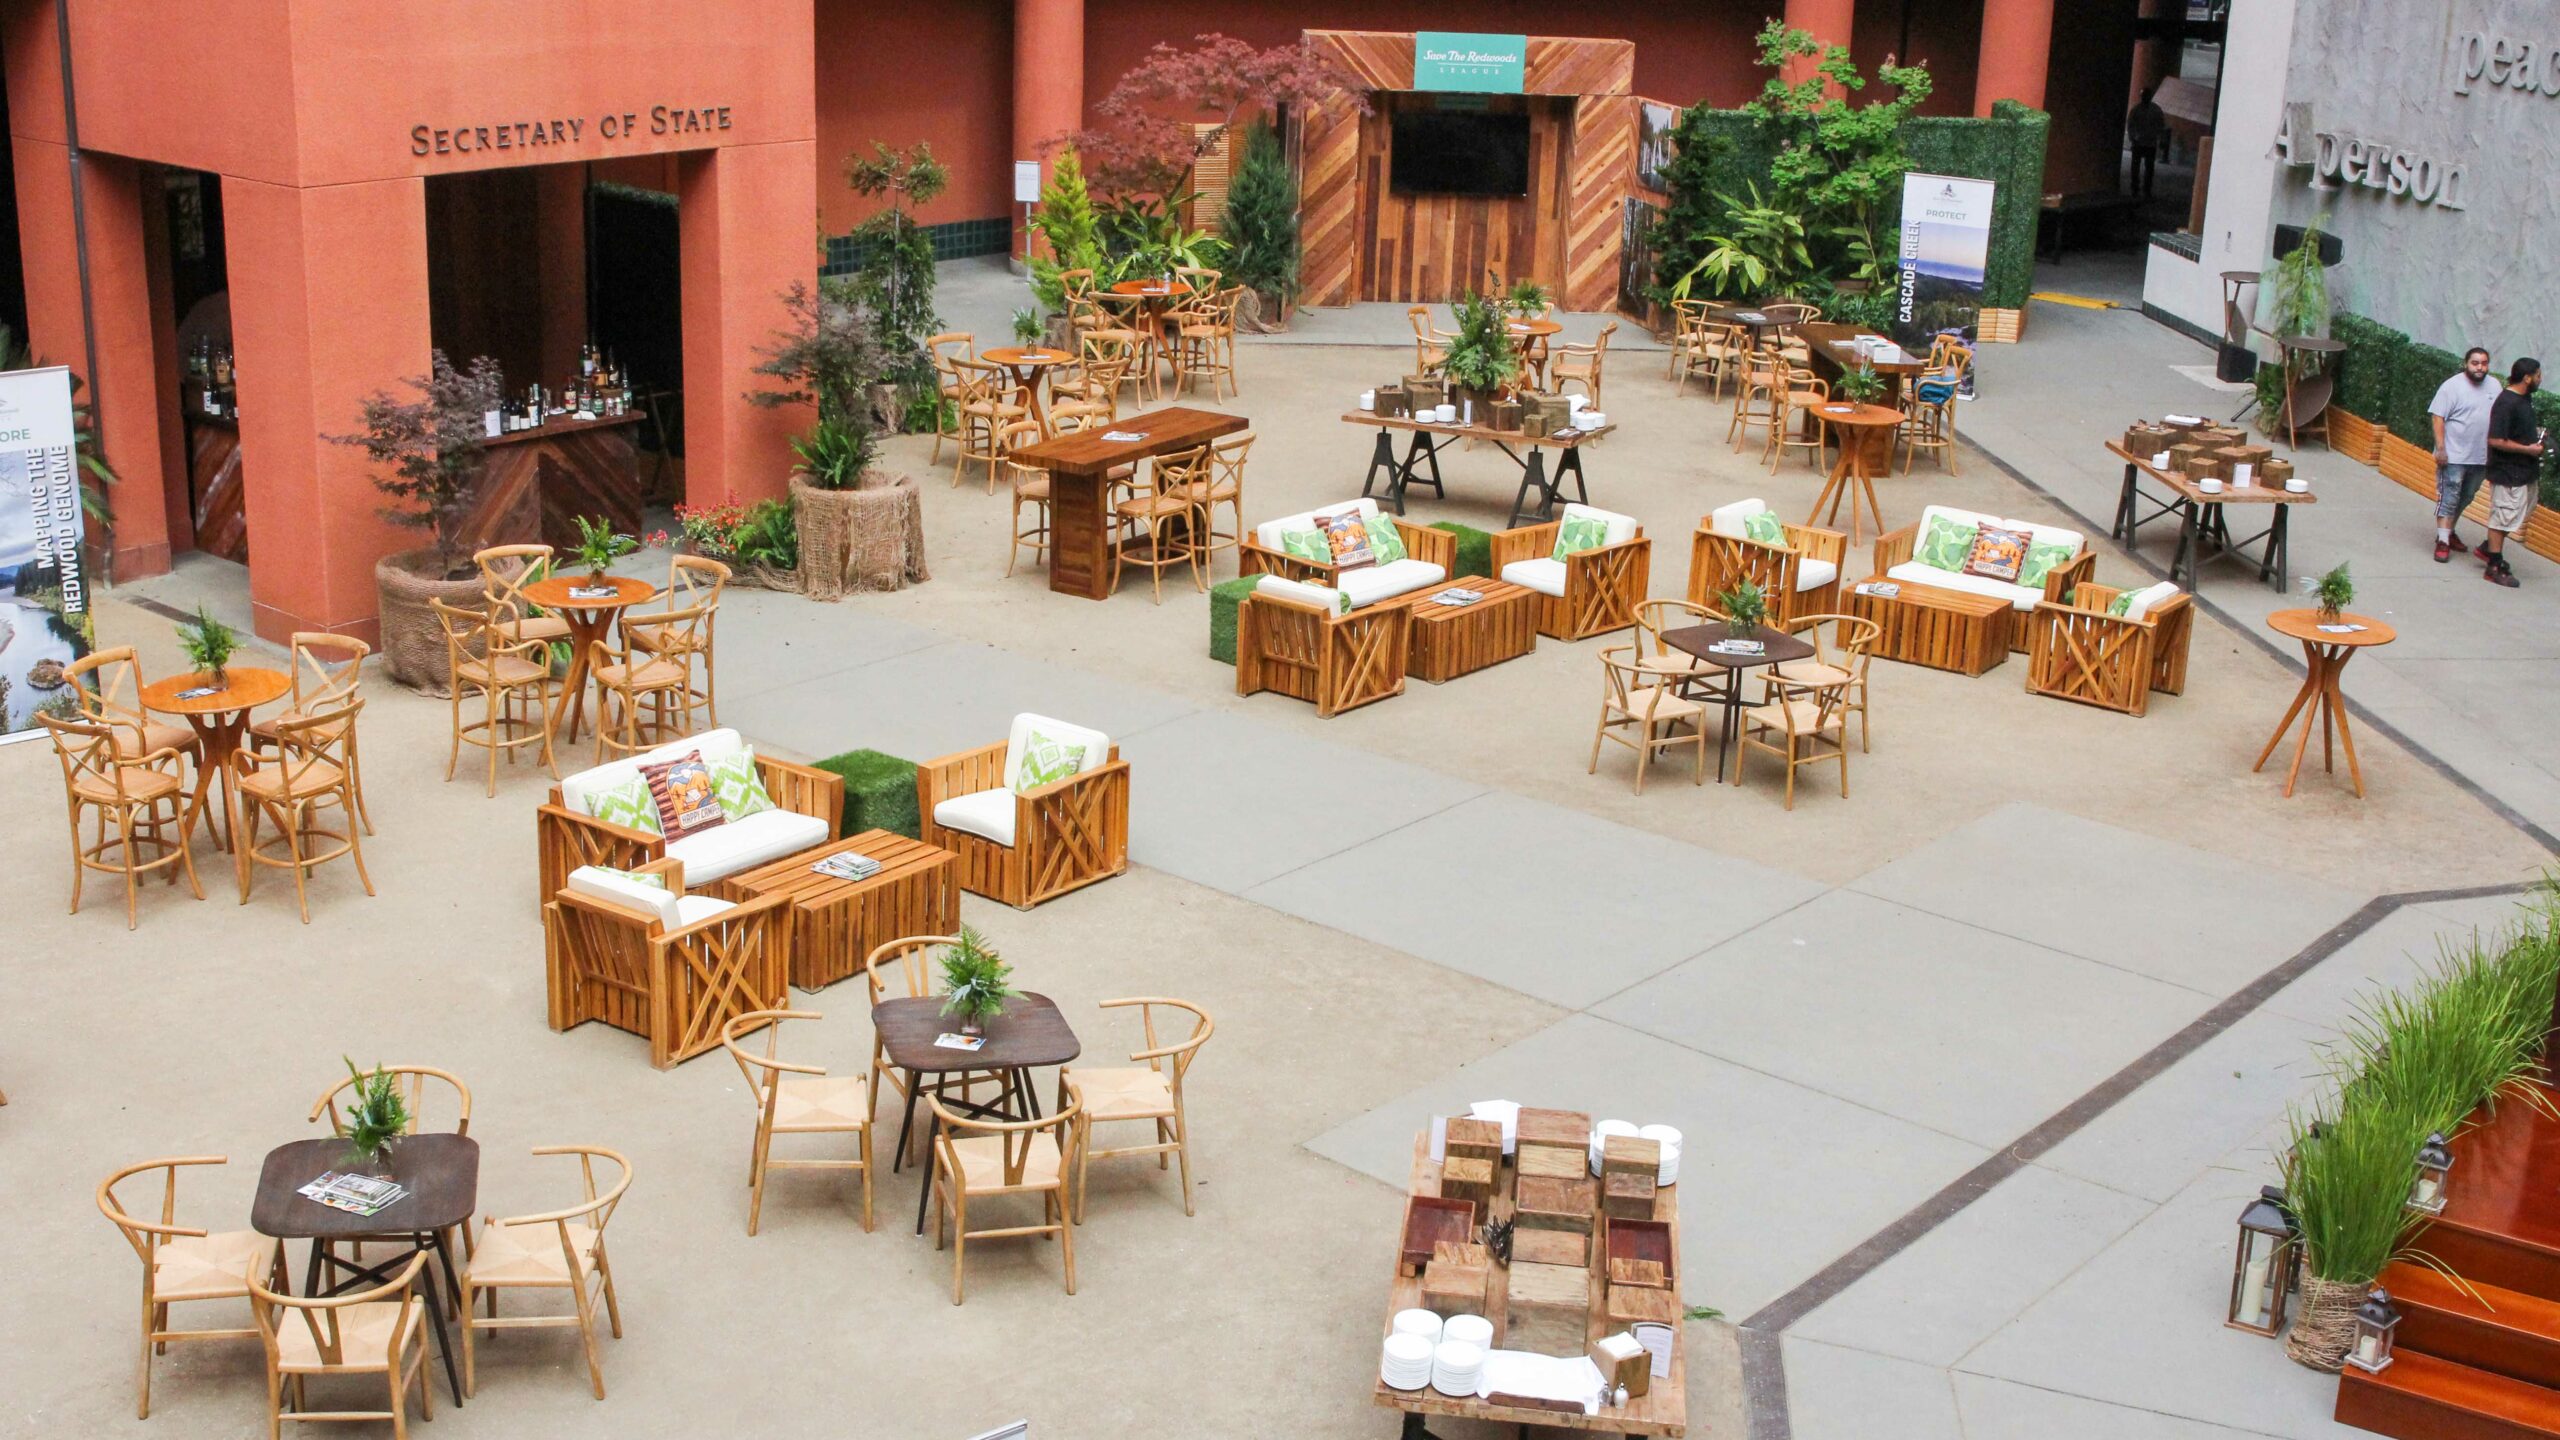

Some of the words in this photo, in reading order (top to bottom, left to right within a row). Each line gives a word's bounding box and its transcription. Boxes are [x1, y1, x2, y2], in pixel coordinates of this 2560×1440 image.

[1423, 50, 1447, 61] Save
[1447, 50, 1466, 62] The
[1467, 51, 1517, 63] Redwoods
[1440, 67, 1499, 75] LEAGUE
[650, 105, 733, 135] STATE
[2265, 102, 2309, 167] A
[2309, 132, 2469, 211] person
[1926, 209, 1967, 220] PROTECT
[1905, 220, 1921, 260] CREEK
[1900, 262, 1916, 323] CASCADE
[27, 448, 46, 483] THE
[50, 445, 74, 521] GENOME
[31, 484, 55, 569] MAPPING
[59, 526, 83, 613] REDWOOD
[681, 811, 700, 824] HAPPY
